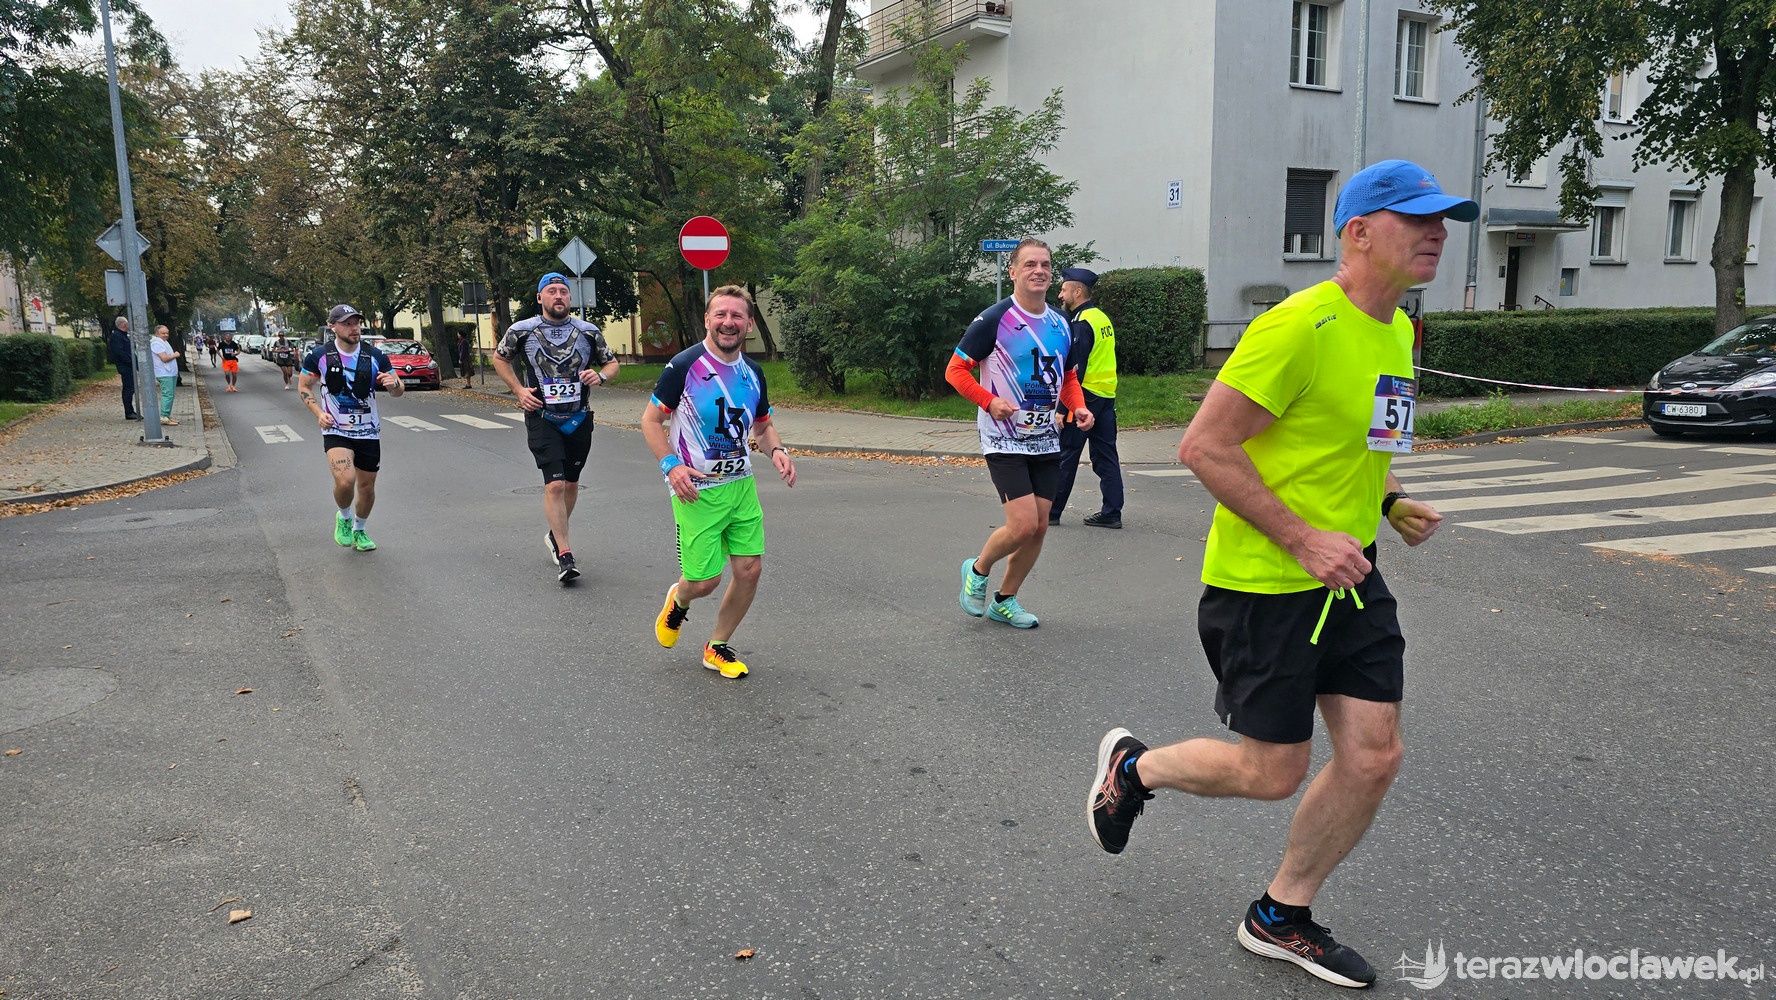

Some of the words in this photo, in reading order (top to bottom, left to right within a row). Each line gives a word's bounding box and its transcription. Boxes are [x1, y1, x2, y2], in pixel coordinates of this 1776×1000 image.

[1169, 188, 1180, 201] 31
[549, 384, 576, 396] 523
[1385, 398, 1415, 431] 57
[1680, 405, 1704, 415] 6380J
[349, 414, 362, 424] 31
[1024, 412, 1051, 426] 354
[711, 459, 746, 474] 452
